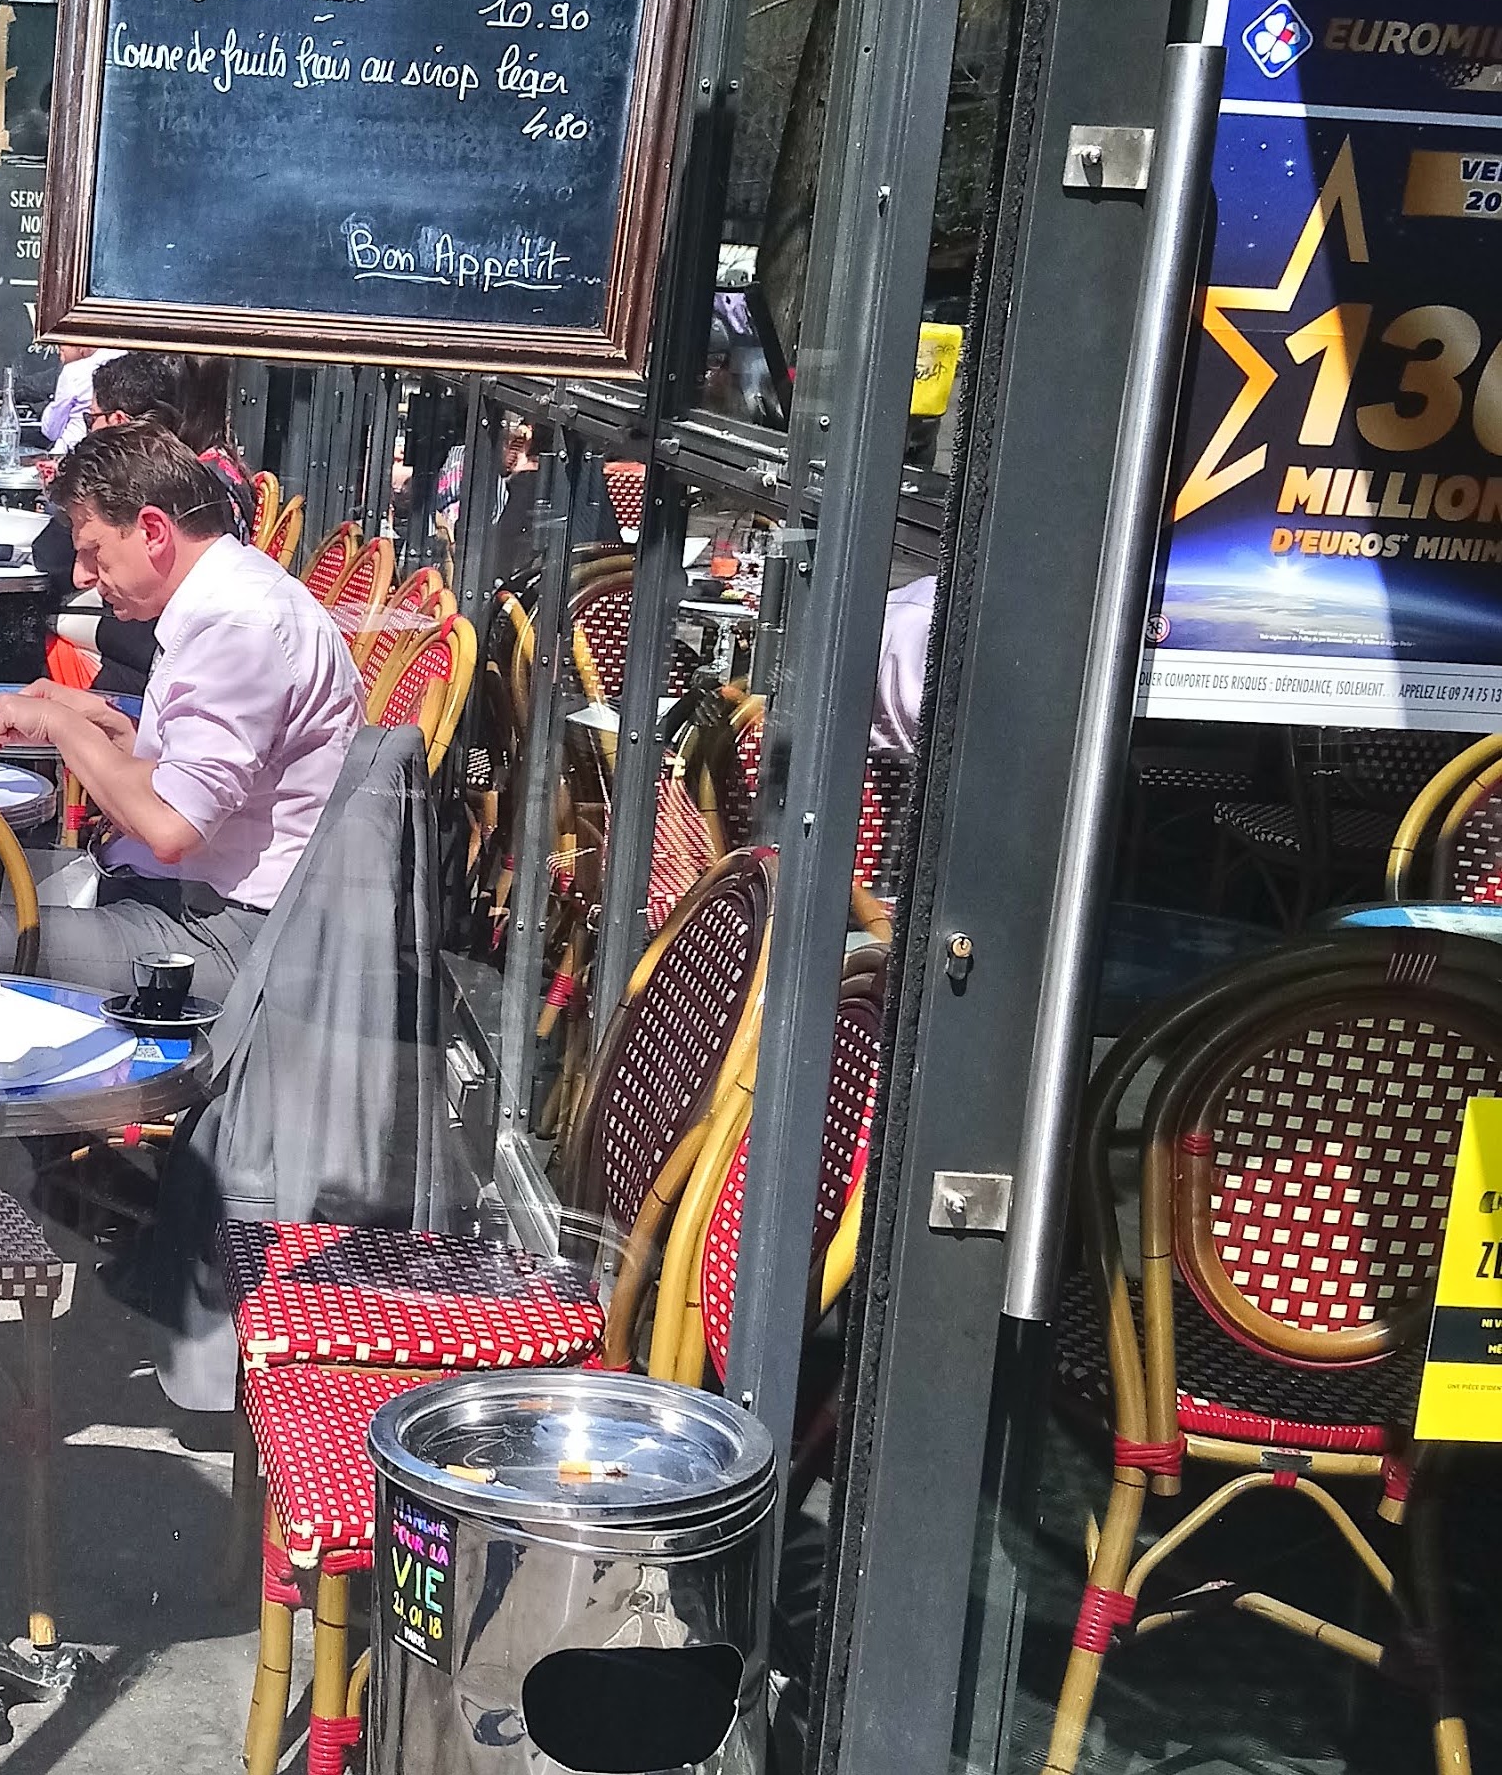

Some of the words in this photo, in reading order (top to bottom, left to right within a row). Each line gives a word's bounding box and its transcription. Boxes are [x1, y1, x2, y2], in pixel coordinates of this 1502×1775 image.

[186, 29, 217, 74] de
[212, 27, 288, 94] fruits
[291, 36, 351, 90] frais
[361, 59, 396, 85] au
[400, 44, 481, 101] sirop
[495, 43, 569, 100] léger
[521, 106, 588, 141] 4.80
[1461, 159, 1502, 182] VE
[1464, 190, 1502, 212] 20
[20, 215, 43, 234] NO
[349, 228, 415, 272] Bon
[1139, 672, 1162, 687] OUER
[1164, 672, 1212, 689] COMPORTE
[1213, 674, 1229, 690] DES
[1231, 675, 1268, 692] RISQUES
[1275, 675, 1333, 697] DÉPENDANCE,
[1399, 683, 1435, 699] APPELEZ
[1436, 685, 1448, 700] LE
[1448, 686, 1460, 701] 09
[1460, 686, 1474, 702] 74
[1476, 687, 1489, 702] 75
[1490, 688, 1502, 703] 13
[392, 1546, 445, 1614] VIE
